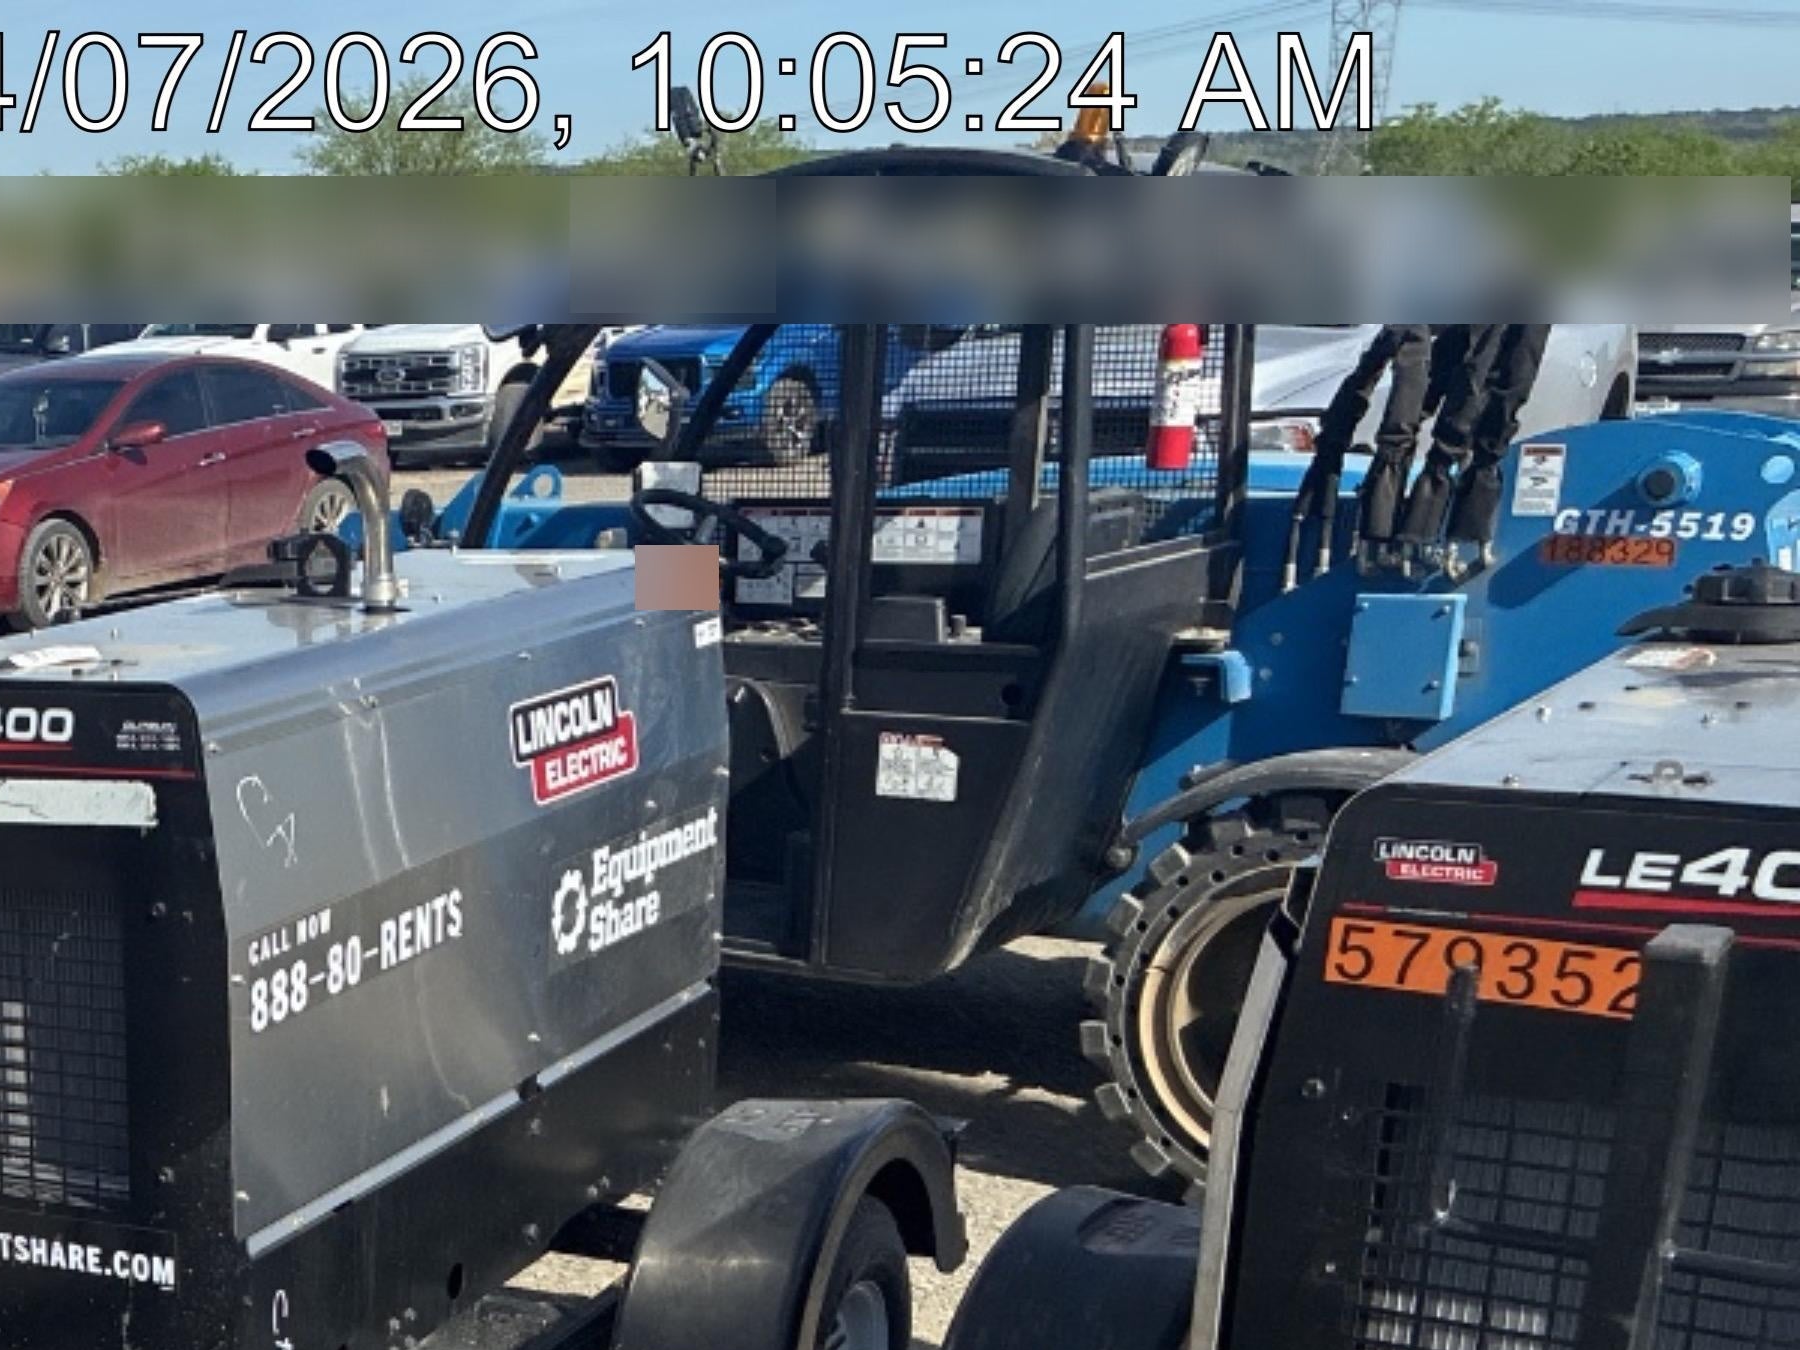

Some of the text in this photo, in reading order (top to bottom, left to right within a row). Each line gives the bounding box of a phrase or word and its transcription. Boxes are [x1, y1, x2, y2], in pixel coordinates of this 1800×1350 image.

[1553, 508, 1756, 541] GTH-5519
[515, 687, 615, 755] LINCOLN
[544, 734, 629, 791] ELECTRIC
[590, 805, 718, 898] Equipment
[1379, 842, 1476, 864] LINCOLN
[1399, 863, 1487, 881] ELECTRIC
[248, 907, 332, 967] CALL NOW
[587, 889, 661, 953] Share
[250, 887, 463, 1034] 888-80-RENTS
